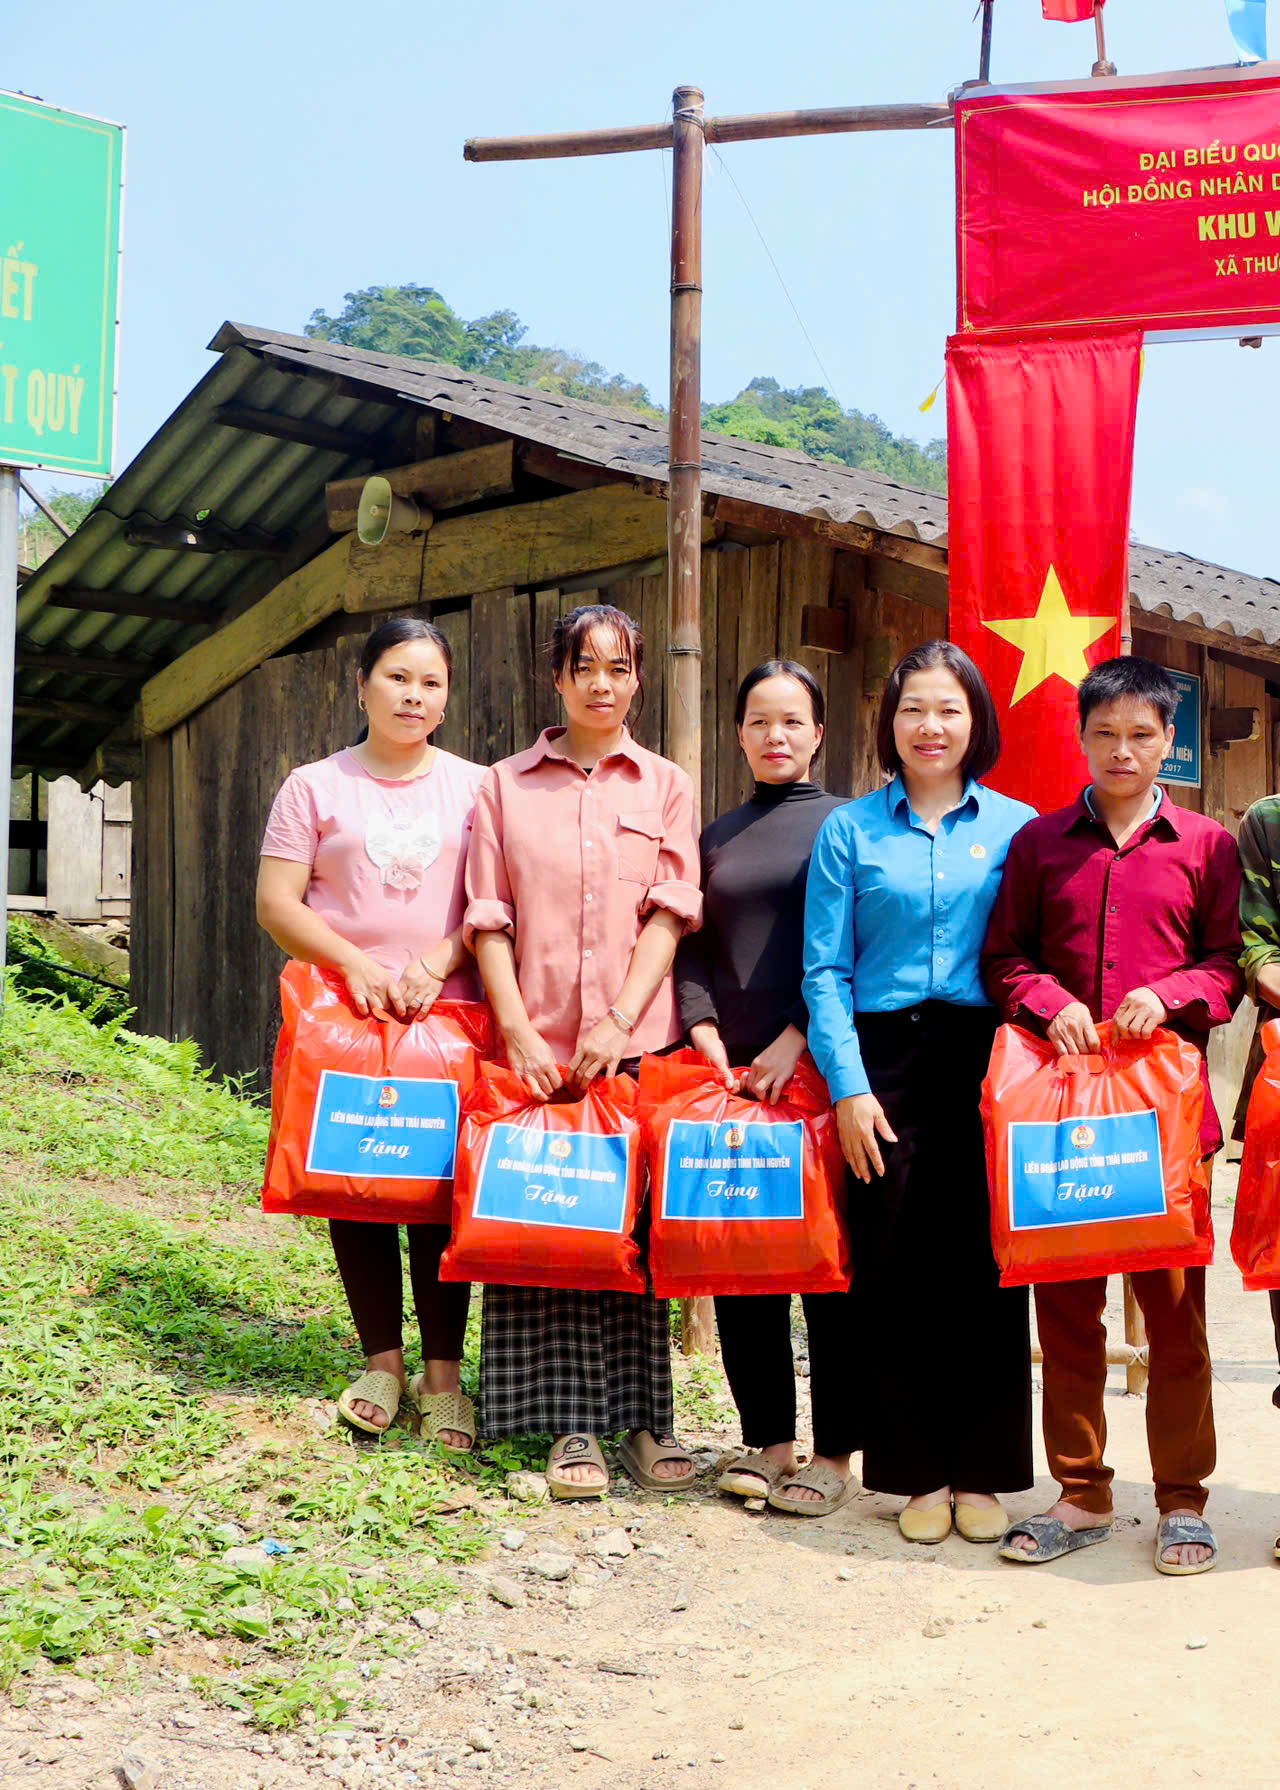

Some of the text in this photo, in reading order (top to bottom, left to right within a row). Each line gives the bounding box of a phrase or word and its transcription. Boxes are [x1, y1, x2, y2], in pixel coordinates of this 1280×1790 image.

[1139, 150, 1177, 172] ĐẠI
[1184, 140, 1236, 167] BIỂU
[1083, 184, 1121, 208] HỘI
[1128, 176, 1193, 203] ĐỒNG
[1201, 171, 1264, 196] NHÂN
[1198, 212, 1256, 241] KHU
[1215, 255, 1239, 276] XÃ
[0, 240, 39, 321] ẾT
[27, 364, 85, 436] QUÝ
[1163, 763, 1181, 775] 2017
[330, 1110, 345, 1123] LIÊN
[358, 1138, 411, 1158] Tặng
[680, 1156, 694, 1168] LIÊN
[710, 1157, 721, 1169] LAO
[738, 1154, 752, 1168] TỈNH
[766, 1155, 791, 1168] NGUYÊN
[1024, 1161, 1040, 1174] LIÊN
[1058, 1160, 1069, 1172] LAO
[1070, 1156, 1088, 1171] ĐỘNG
[1106, 1152, 1120, 1166] THÁI
[1121, 1150, 1149, 1164] NGUYÊN
[524, 1185, 581, 1208] Tặng
[706, 1180, 760, 1200] Tặng
[1057, 1182, 1114, 1202] Tặng
